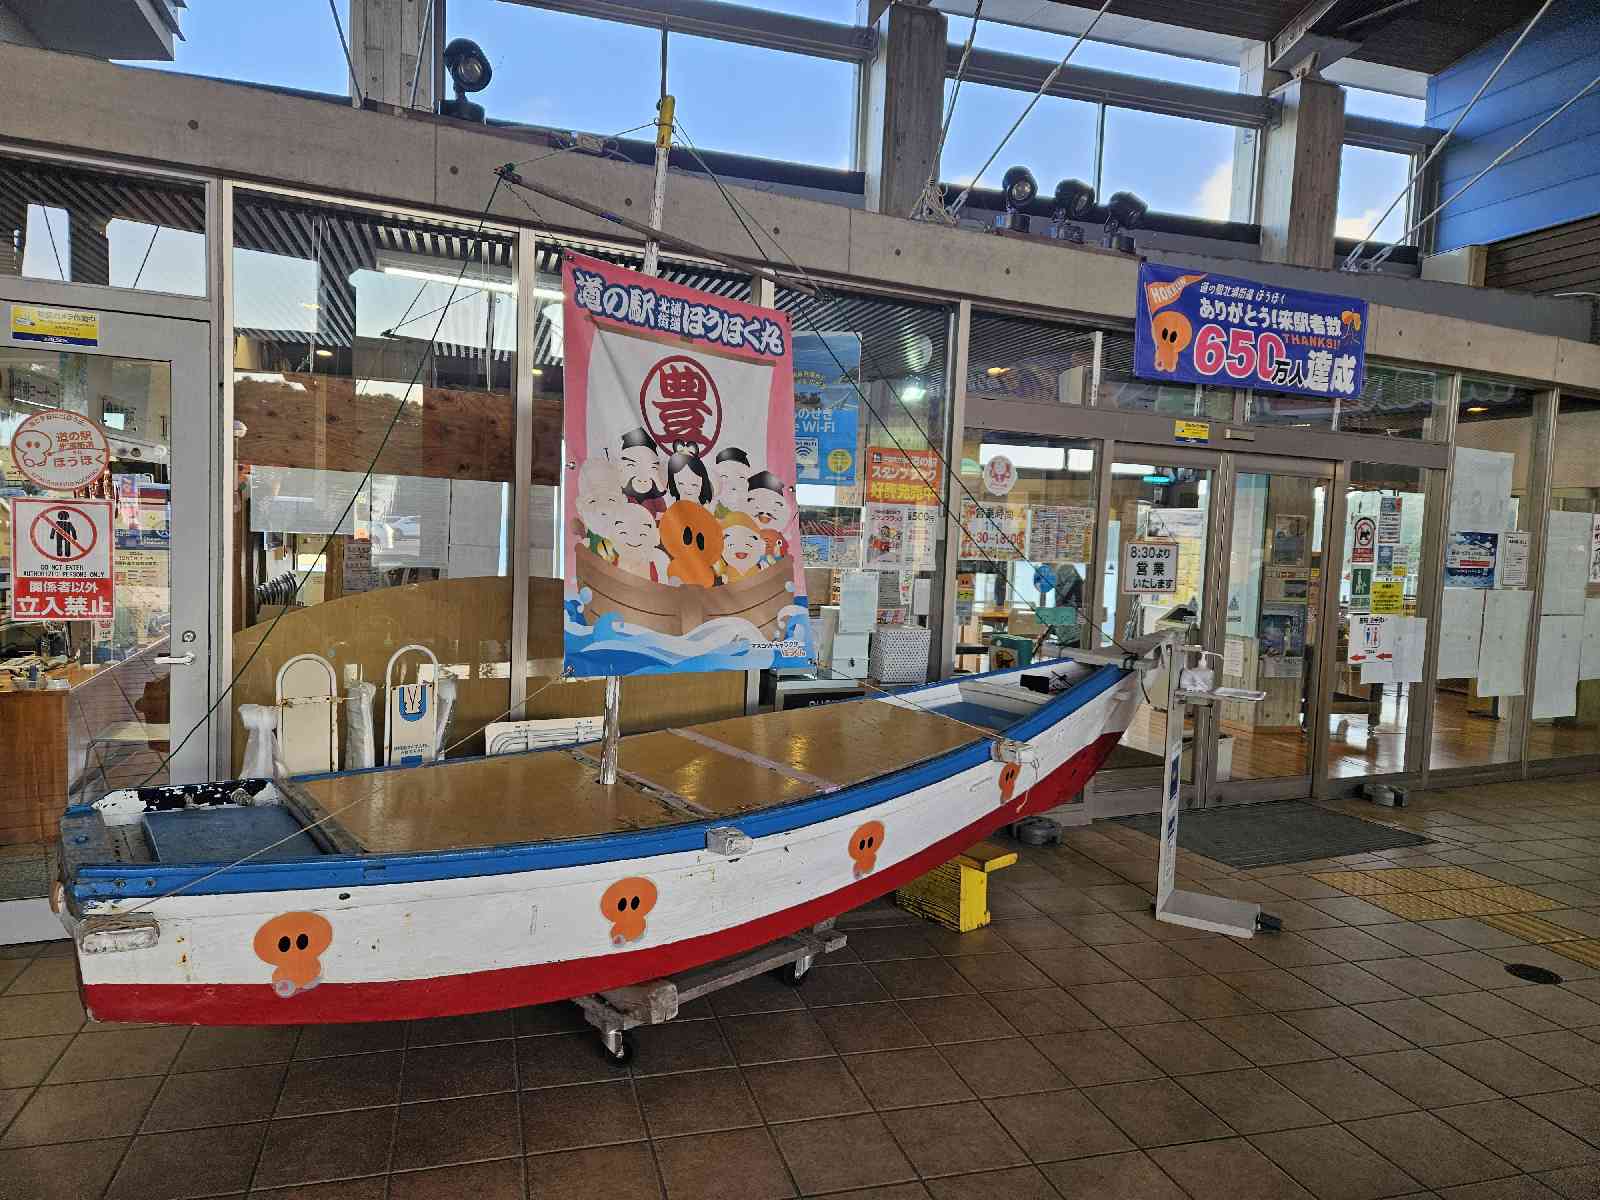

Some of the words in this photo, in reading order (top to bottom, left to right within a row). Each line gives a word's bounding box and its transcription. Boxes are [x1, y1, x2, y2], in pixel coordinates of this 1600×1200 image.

[1136, 560, 1165, 576] 営業
[29, 581, 98, 593] 関係者以外
[1133, 578, 1173, 588] いたします
[16, 595, 111, 616] 立入禁止
